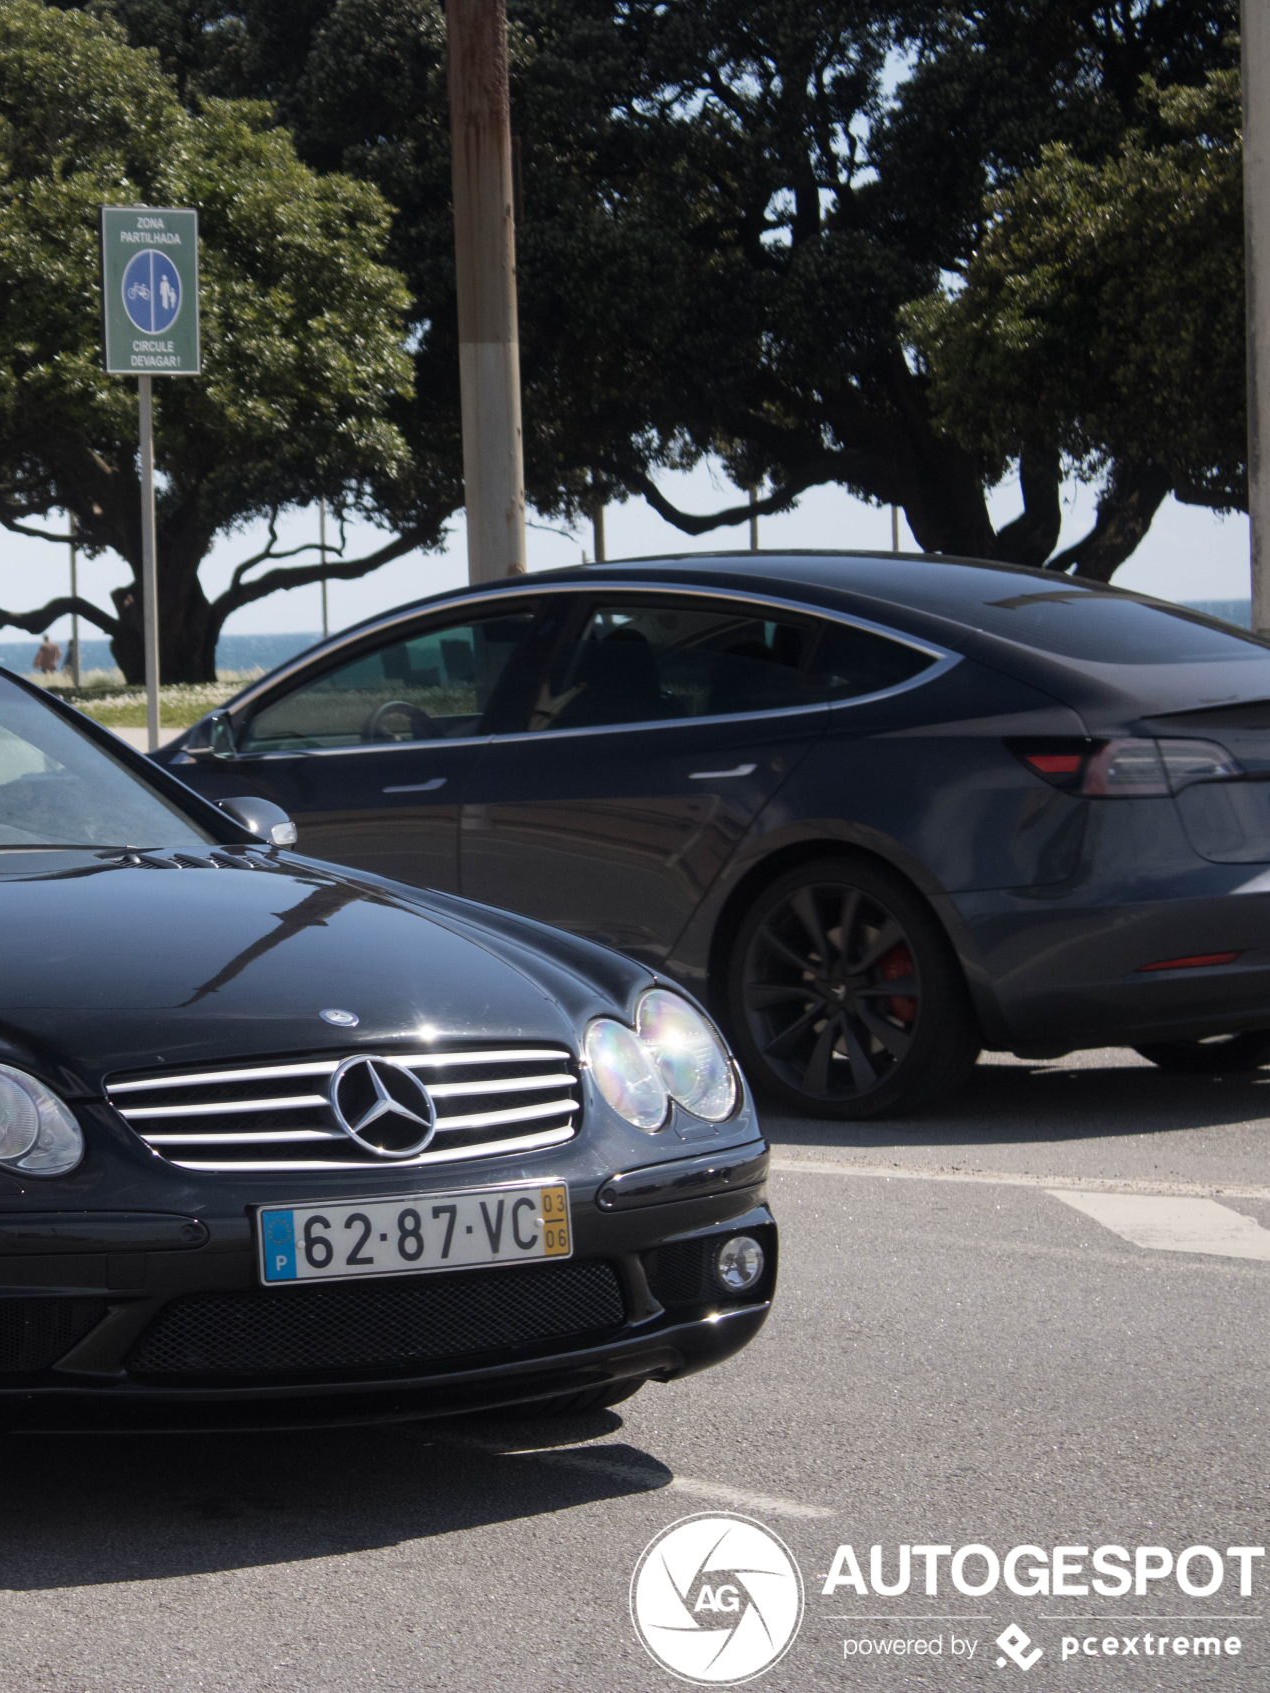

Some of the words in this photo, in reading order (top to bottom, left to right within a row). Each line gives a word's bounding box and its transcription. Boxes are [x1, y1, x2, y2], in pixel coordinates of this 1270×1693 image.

[137, 217, 164, 229] ZONA
[120, 231, 181, 244] PARTILHADA
[132, 340, 174, 352] CIRCULE
[543, 1194, 566, 1213] 03
[545, 1230, 568, 1249] 06
[275, 1255, 288, 1272] P
